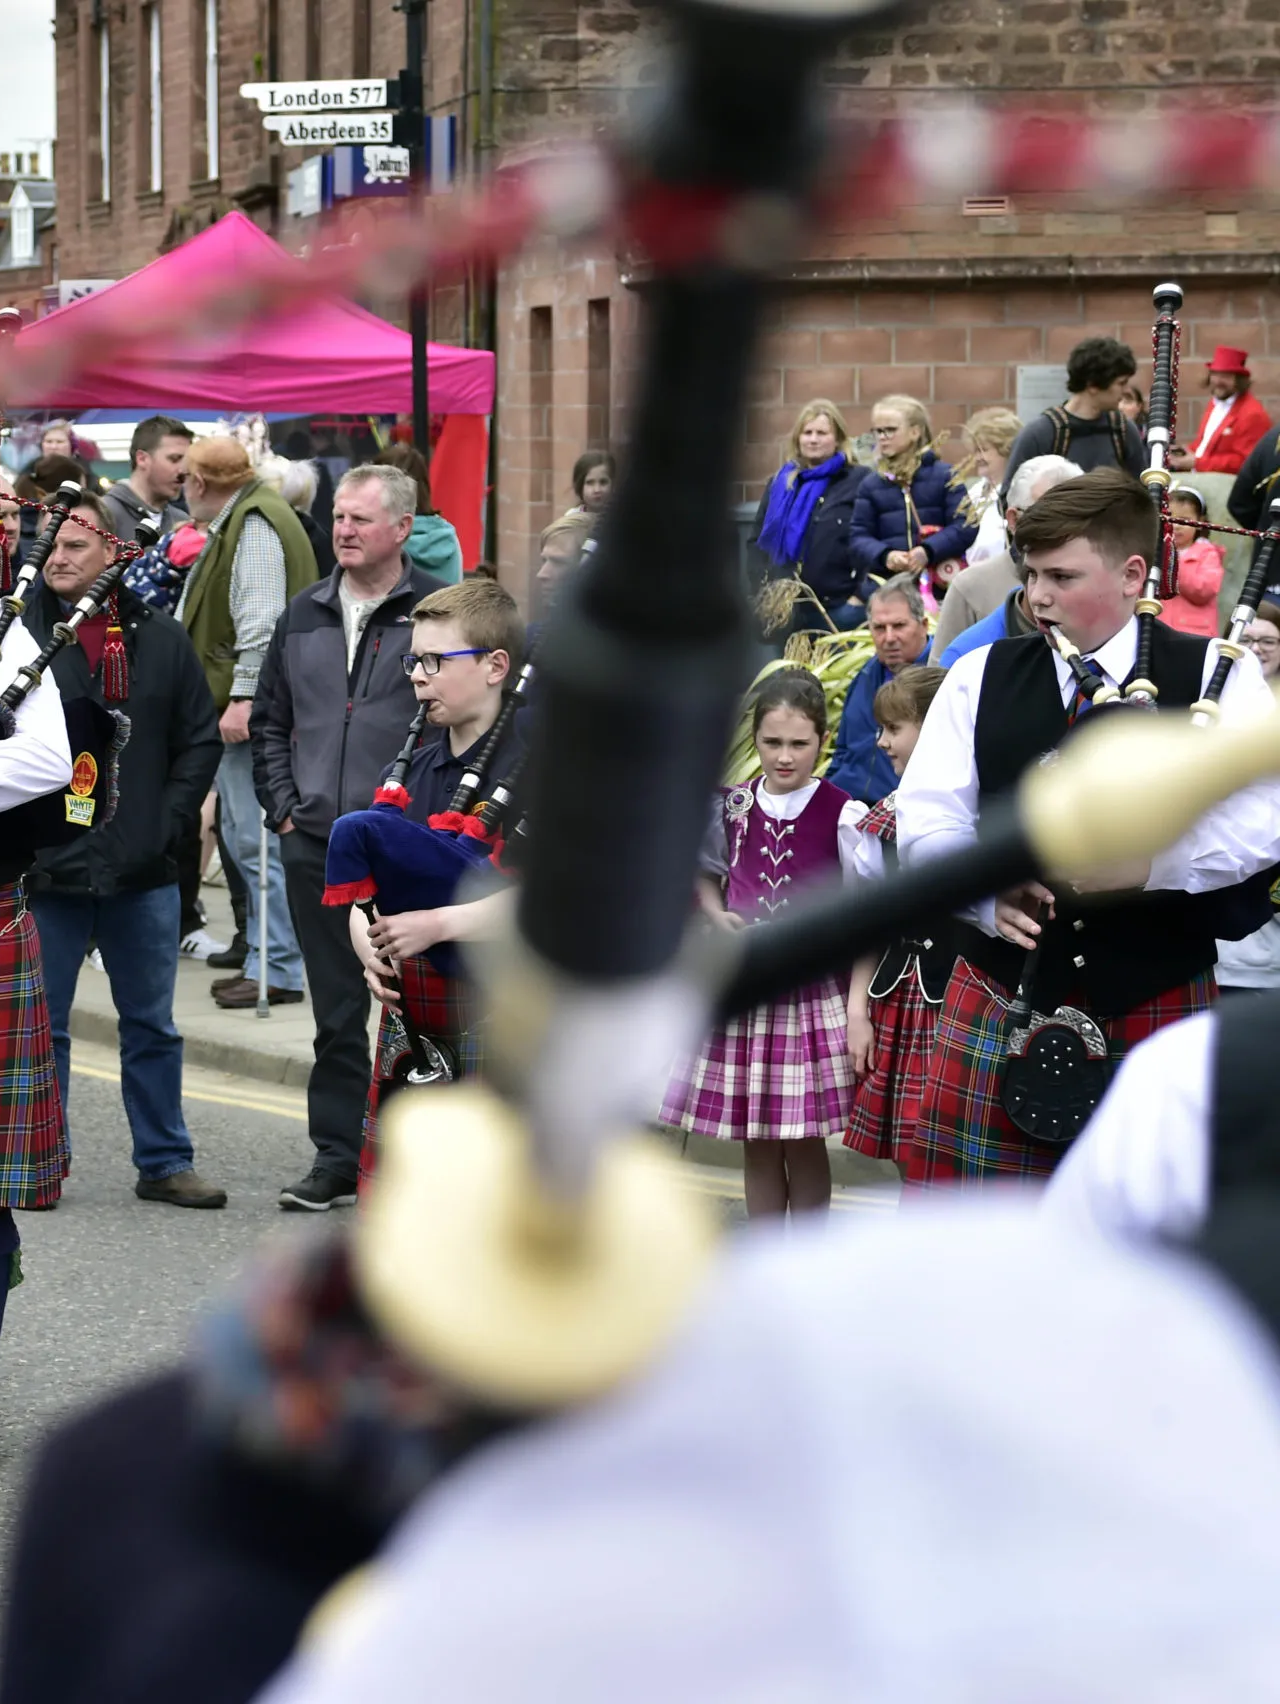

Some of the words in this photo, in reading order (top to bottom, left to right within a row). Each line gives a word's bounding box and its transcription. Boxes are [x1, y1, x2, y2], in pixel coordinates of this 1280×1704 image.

[269, 89, 344, 108] London
[350, 87, 383, 104] 577
[285, 121, 366, 140] Aberdeen
[370, 122, 389, 138] 35
[68, 798, 93, 811] WHYTE
